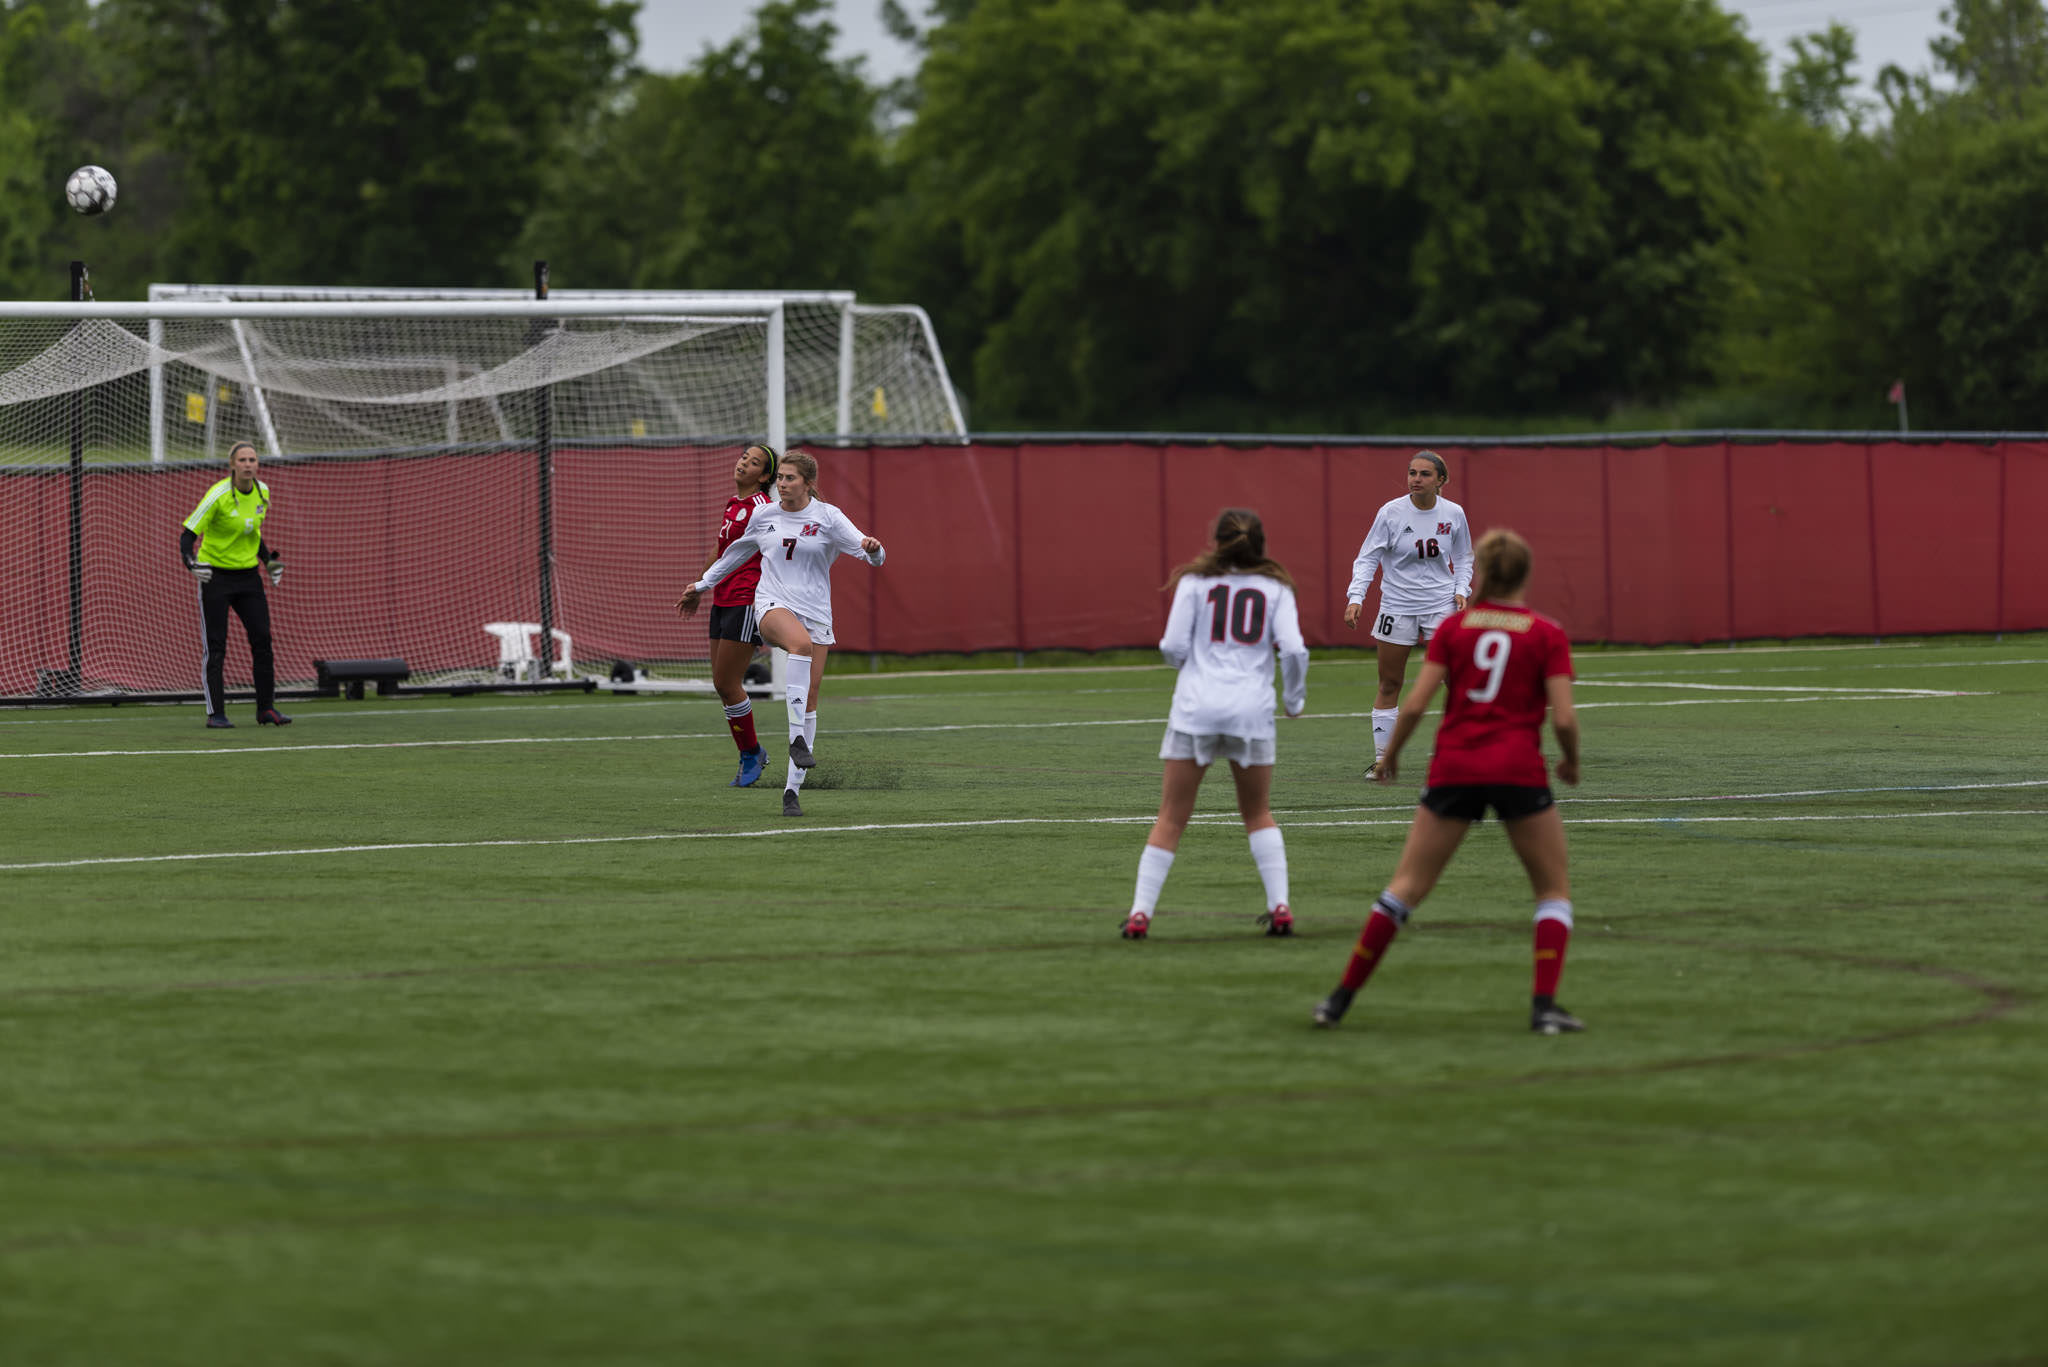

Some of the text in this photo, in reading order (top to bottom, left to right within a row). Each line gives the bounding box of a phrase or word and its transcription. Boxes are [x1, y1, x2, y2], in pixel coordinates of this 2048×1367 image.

[782, 538, 797, 560] 7
[1415, 538, 1440, 559] 16
[1207, 584, 1266, 646] 10
[1377, 613, 1395, 636] 16
[1466, 631, 1511, 703] 9
